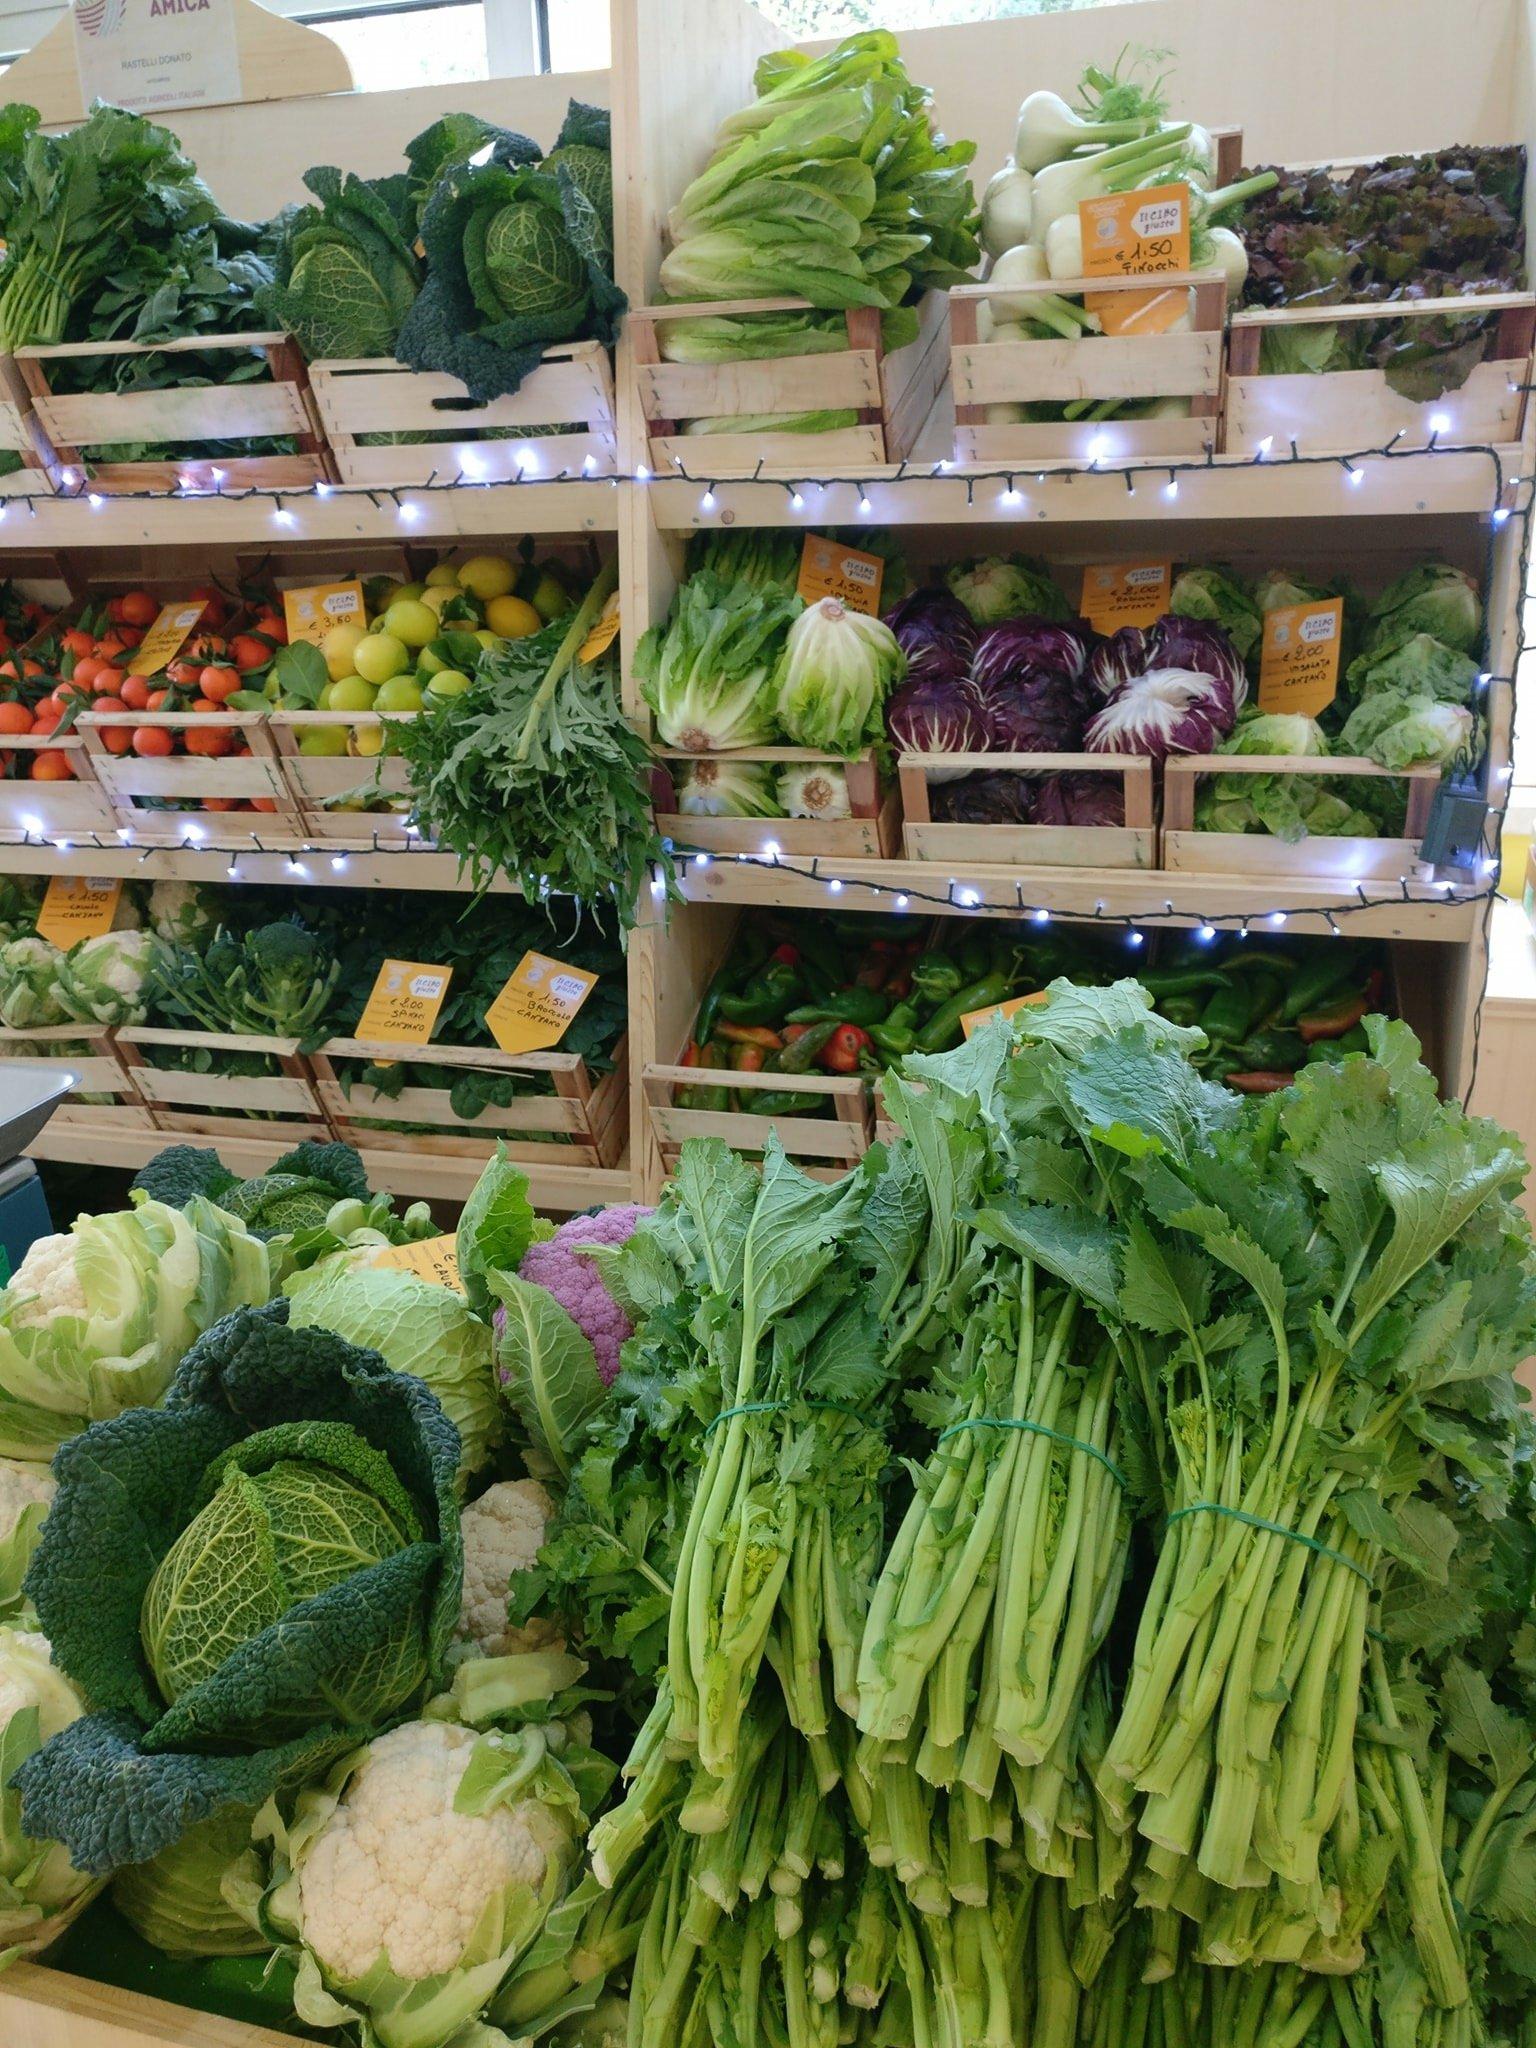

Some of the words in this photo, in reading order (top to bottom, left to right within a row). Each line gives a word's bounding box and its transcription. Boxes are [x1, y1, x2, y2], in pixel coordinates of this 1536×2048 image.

[150, 0, 211, 17] AMICA
[159, 52, 192, 64] DONATO
[1115, 250, 1125, 261] €
